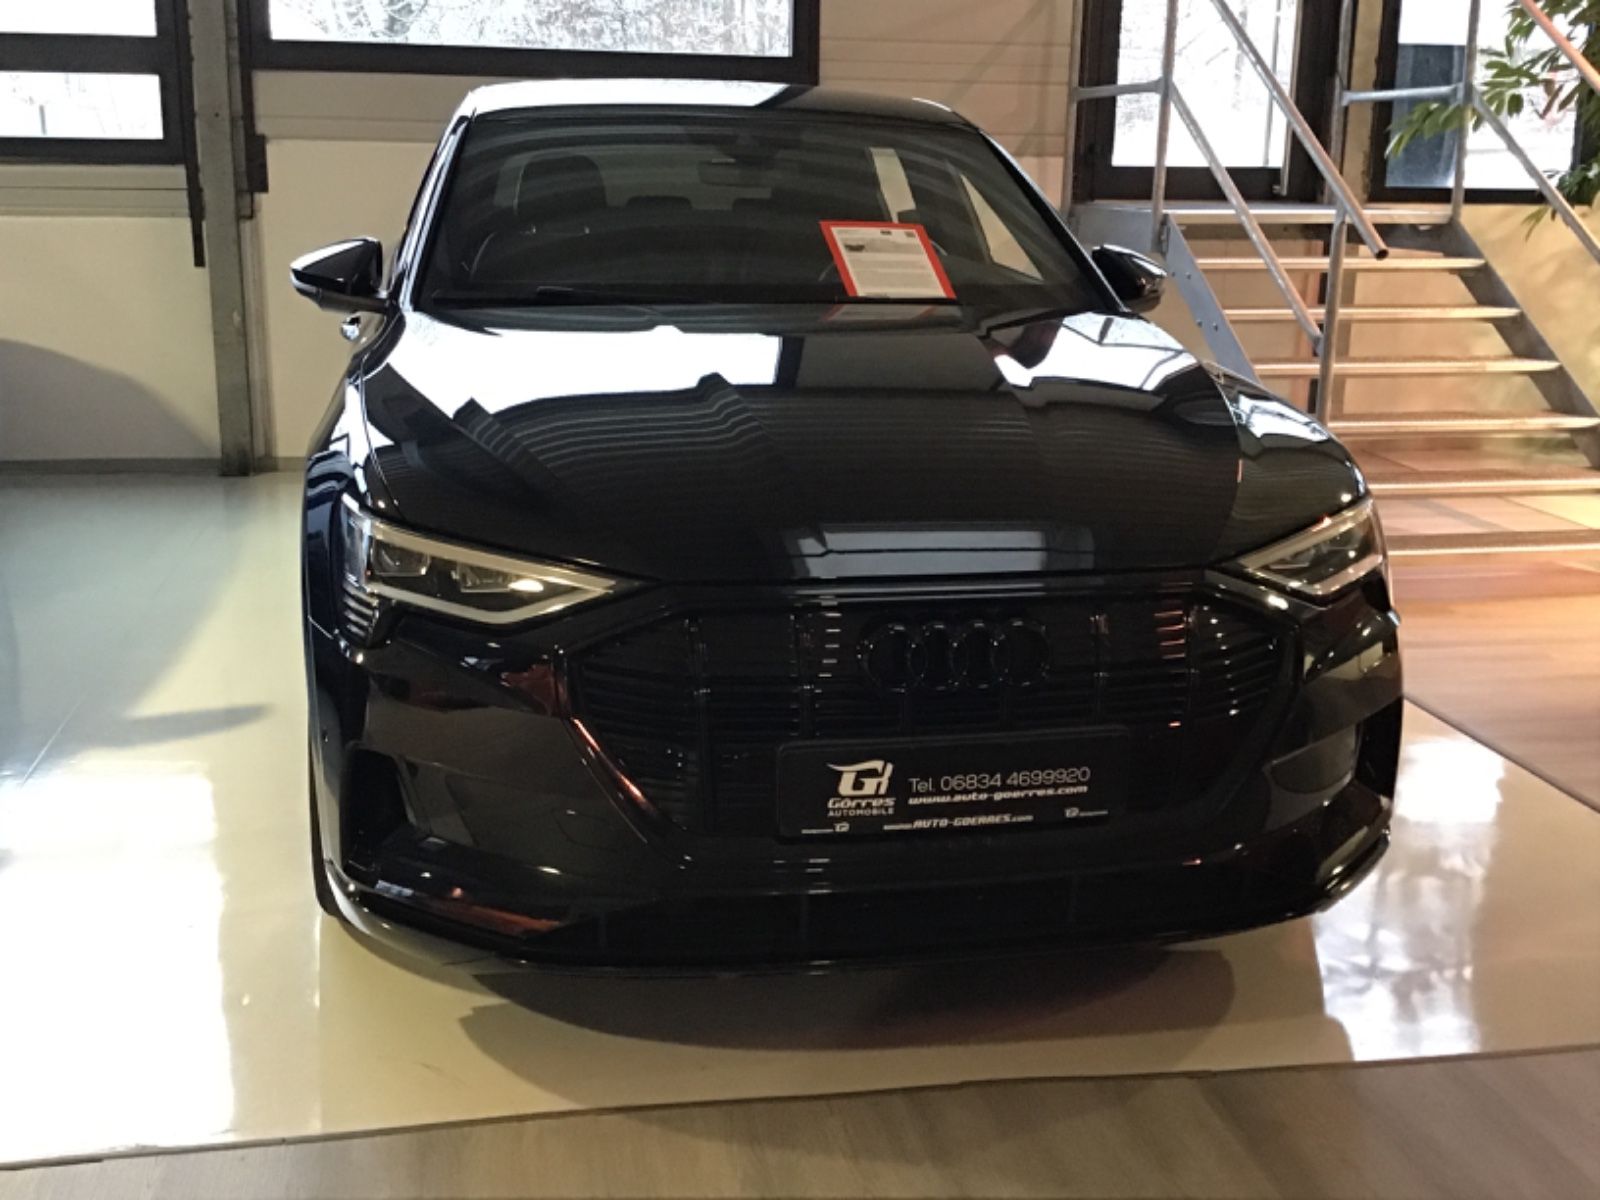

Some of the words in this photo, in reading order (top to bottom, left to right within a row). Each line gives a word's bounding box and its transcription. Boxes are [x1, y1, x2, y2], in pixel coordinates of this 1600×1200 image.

[908, 777, 934, 793] Tel.
[940, 774, 1001, 792] 06834
[1006, 766, 1091, 787] 4699920
[908, 785, 1088, 805] www.auto-goerres.com
[827, 807, 895, 818] AUTOMOBILE
